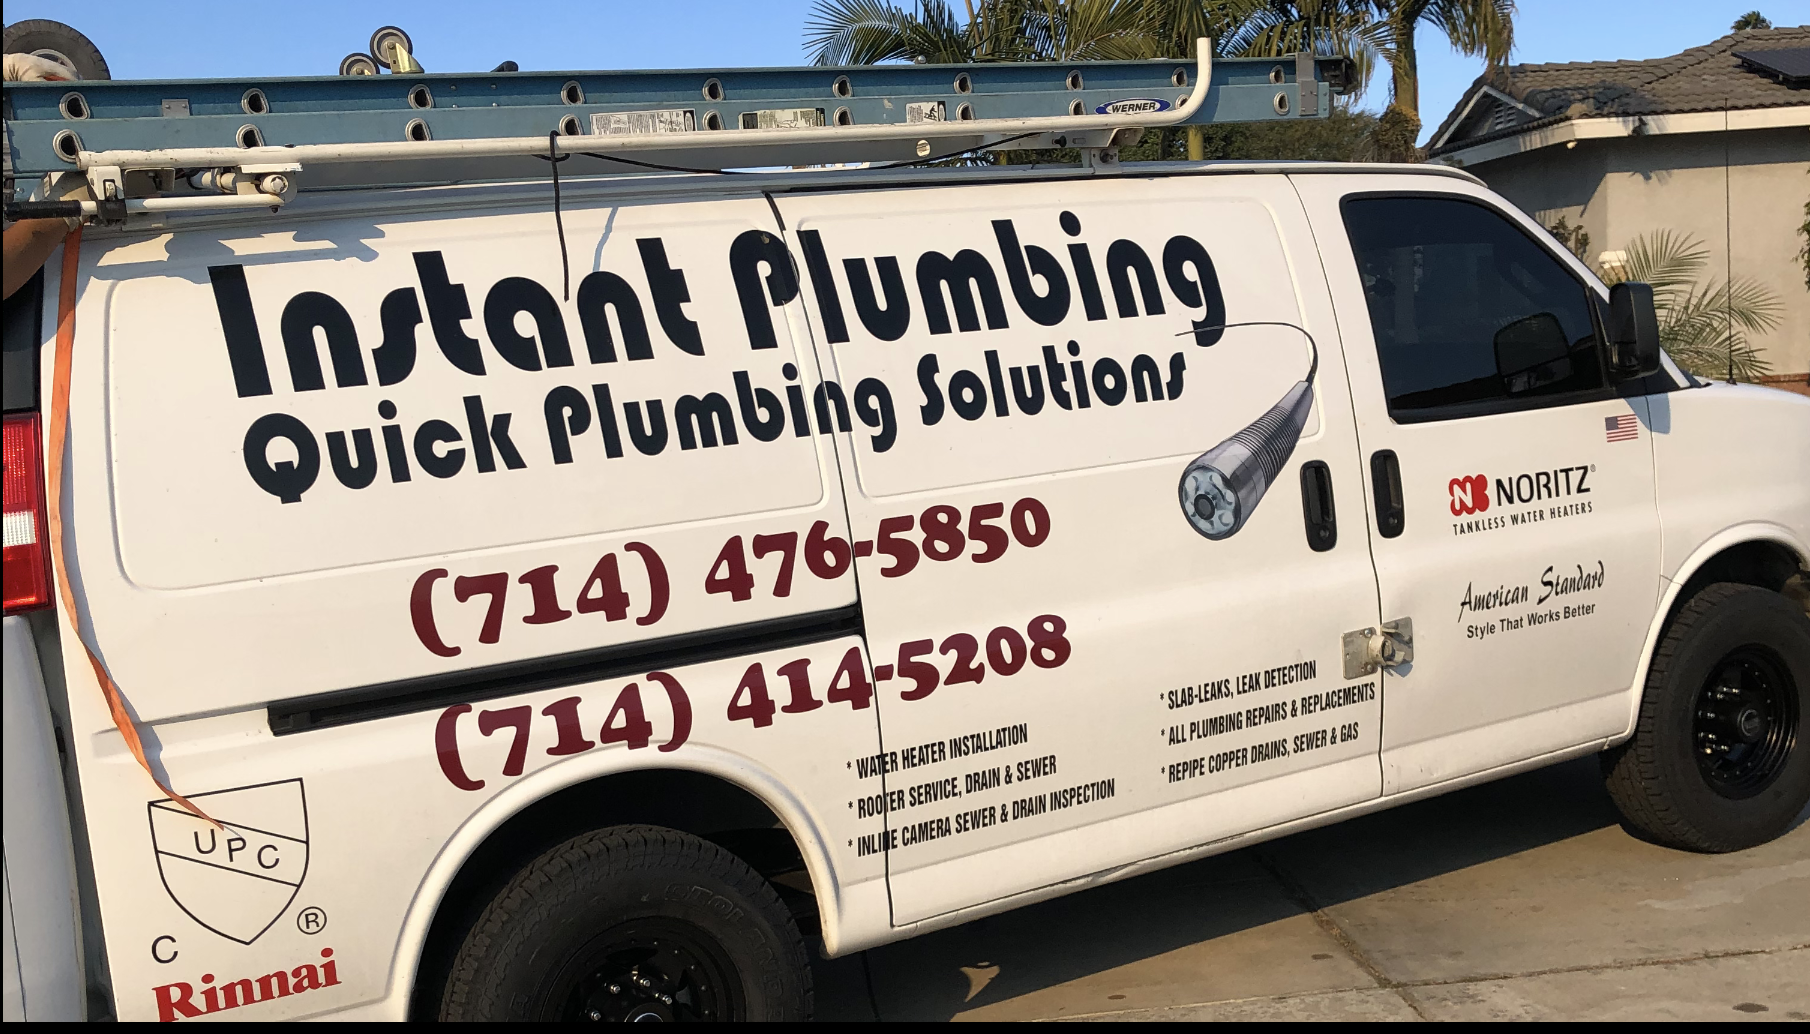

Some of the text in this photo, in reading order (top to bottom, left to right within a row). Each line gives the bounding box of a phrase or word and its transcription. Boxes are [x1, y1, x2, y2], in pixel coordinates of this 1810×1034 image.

[1111, 102, 1157, 113] WERNER
[207, 210, 1226, 398] Instant Plumbing
[243, 339, 1186, 504] Quick Plumbing Solutions
[1453, 501, 1593, 536] TANKLESS WATER HEATERS
[409, 497, 1051, 658] (714) 476-5850
[1458, 560, 1605, 623] American Standard
[1466, 603, 1596, 640] Style That Works Better
[434, 614, 1072, 791] (714) 414-5208
[1168, 660, 1317, 710] SLAB-LEAKS, LEAK DETECTION
[1168, 682, 1376, 746] ALL PLUMBING REPAIRS & REPLACEMENTS
[856, 723, 1028, 780] WATER HEATER INSTALLATION
[1168, 721, 1359, 783] REPIPE COPPER DRAINS, SEWER & GAS
[857, 778, 1116, 857] INLINE CAMERA SEWER & DRAIN INSPECTION
[858, 754, 1057, 819] ROOTER SERVICE, DRAIN & SEWER
[151, 935, 179, 964] C
[151, 947, 342, 1022] Rinnai
